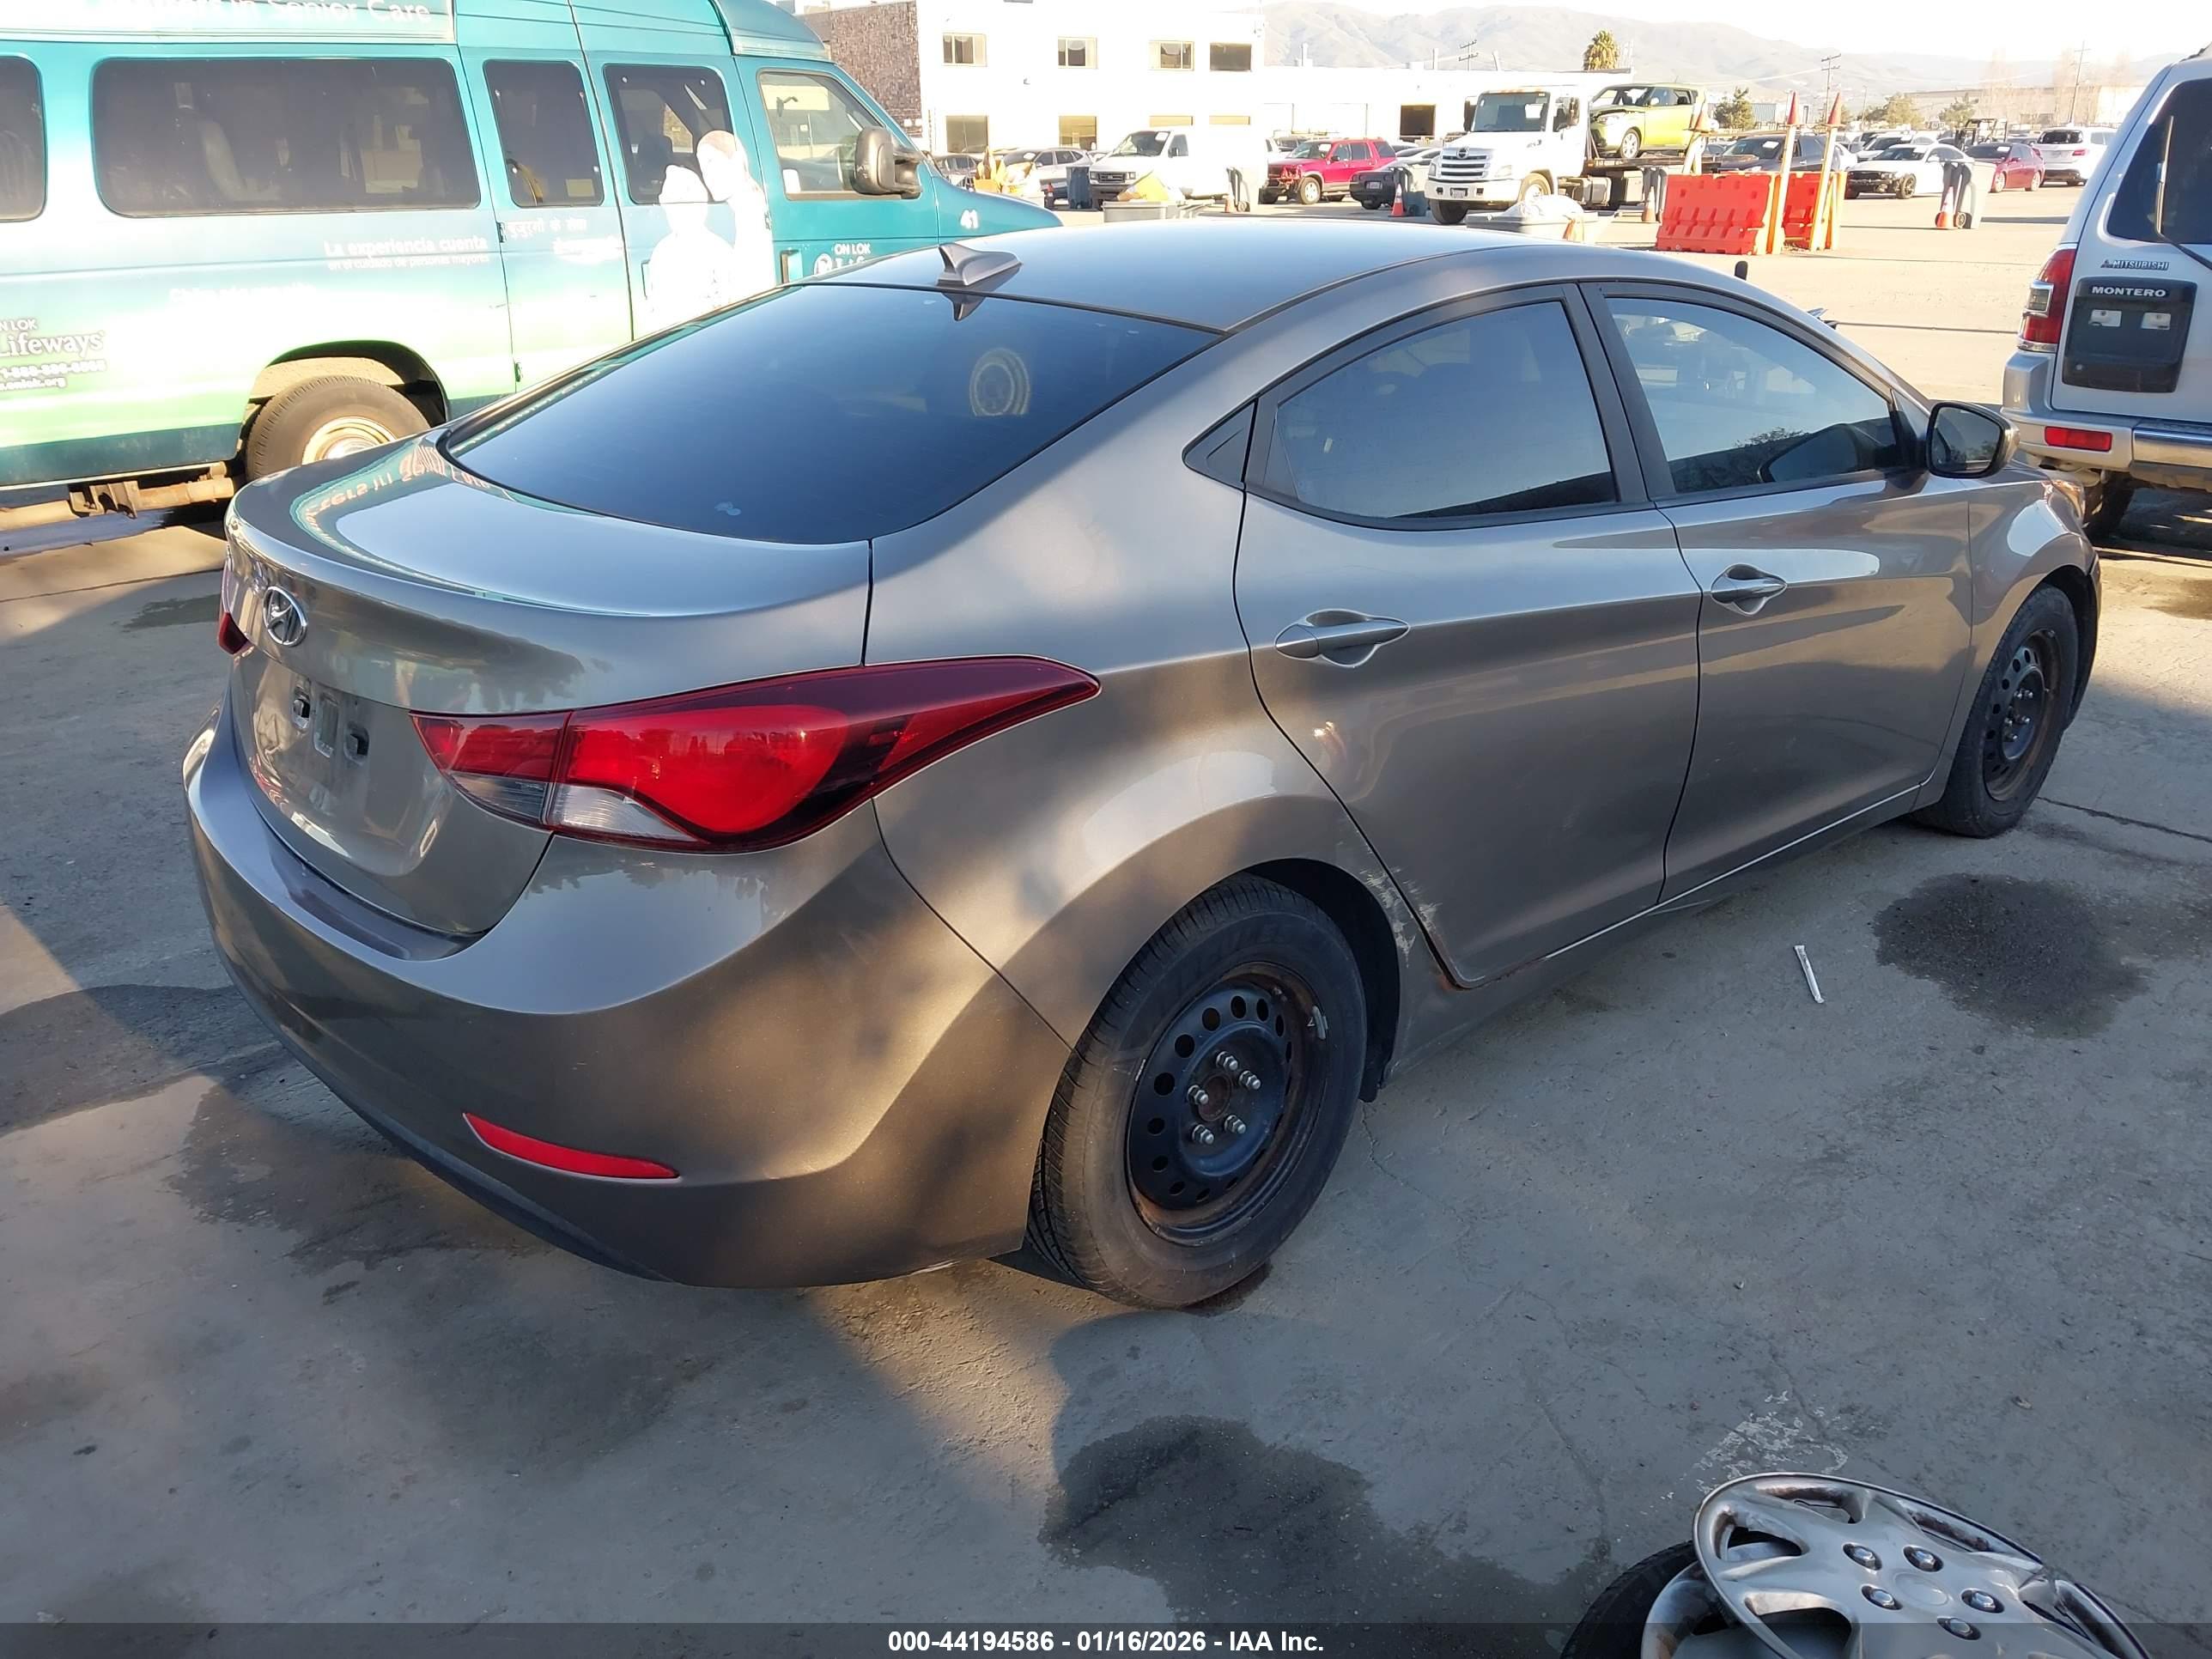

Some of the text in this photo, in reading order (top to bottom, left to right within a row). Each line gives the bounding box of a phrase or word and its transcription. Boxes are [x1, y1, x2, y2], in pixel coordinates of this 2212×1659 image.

[267, 0, 357, 21] Senior
[367, 0, 431, 22] Care
[960, 210, 980, 229] 41
[439, 235, 489, 252] cuenta
[834, 242, 872, 255] ON LOK
[2112, 260, 2170, 270] MITSUBISHI
[2092, 286, 2166, 297] MONTERO
[9, 319, 38, 331] LOK
